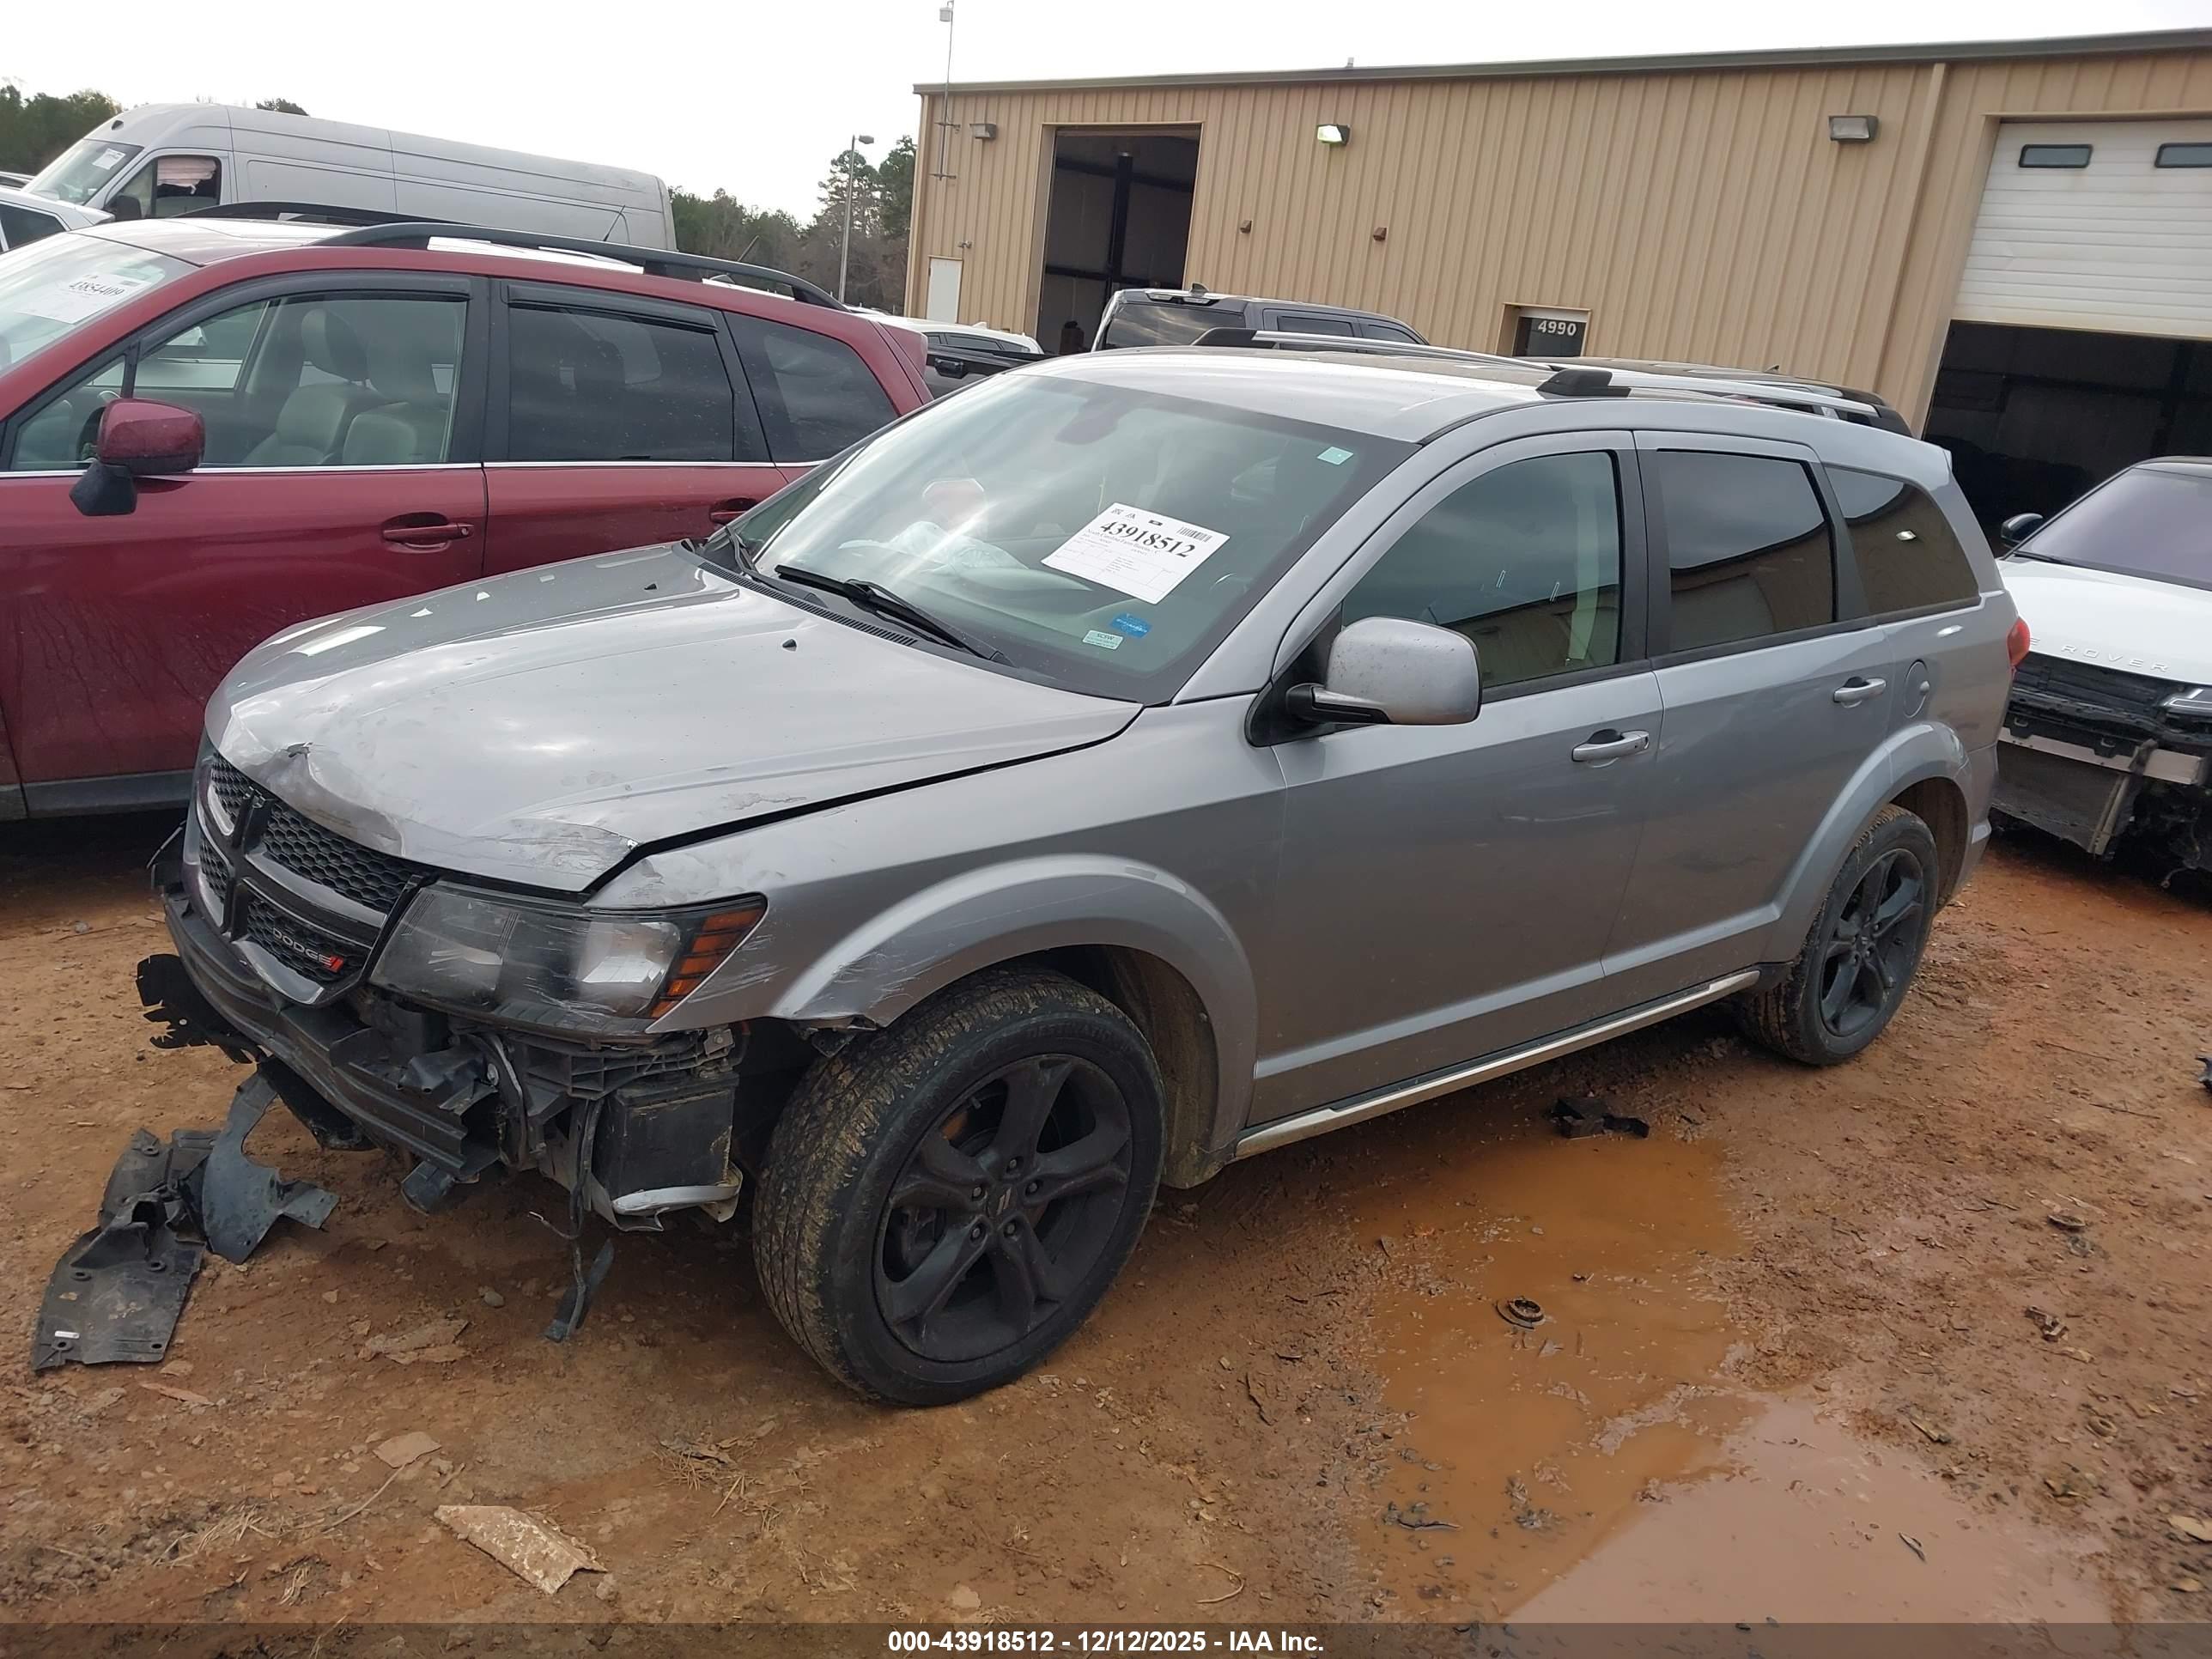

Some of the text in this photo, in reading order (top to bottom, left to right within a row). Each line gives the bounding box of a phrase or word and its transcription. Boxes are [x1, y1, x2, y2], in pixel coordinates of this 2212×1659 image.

[1538, 320, 1577, 336] 4990
[1100, 521, 1195, 557] 43918512
[2061, 644, 2168, 672] ROVER
[272, 927, 332, 967] DODGE
